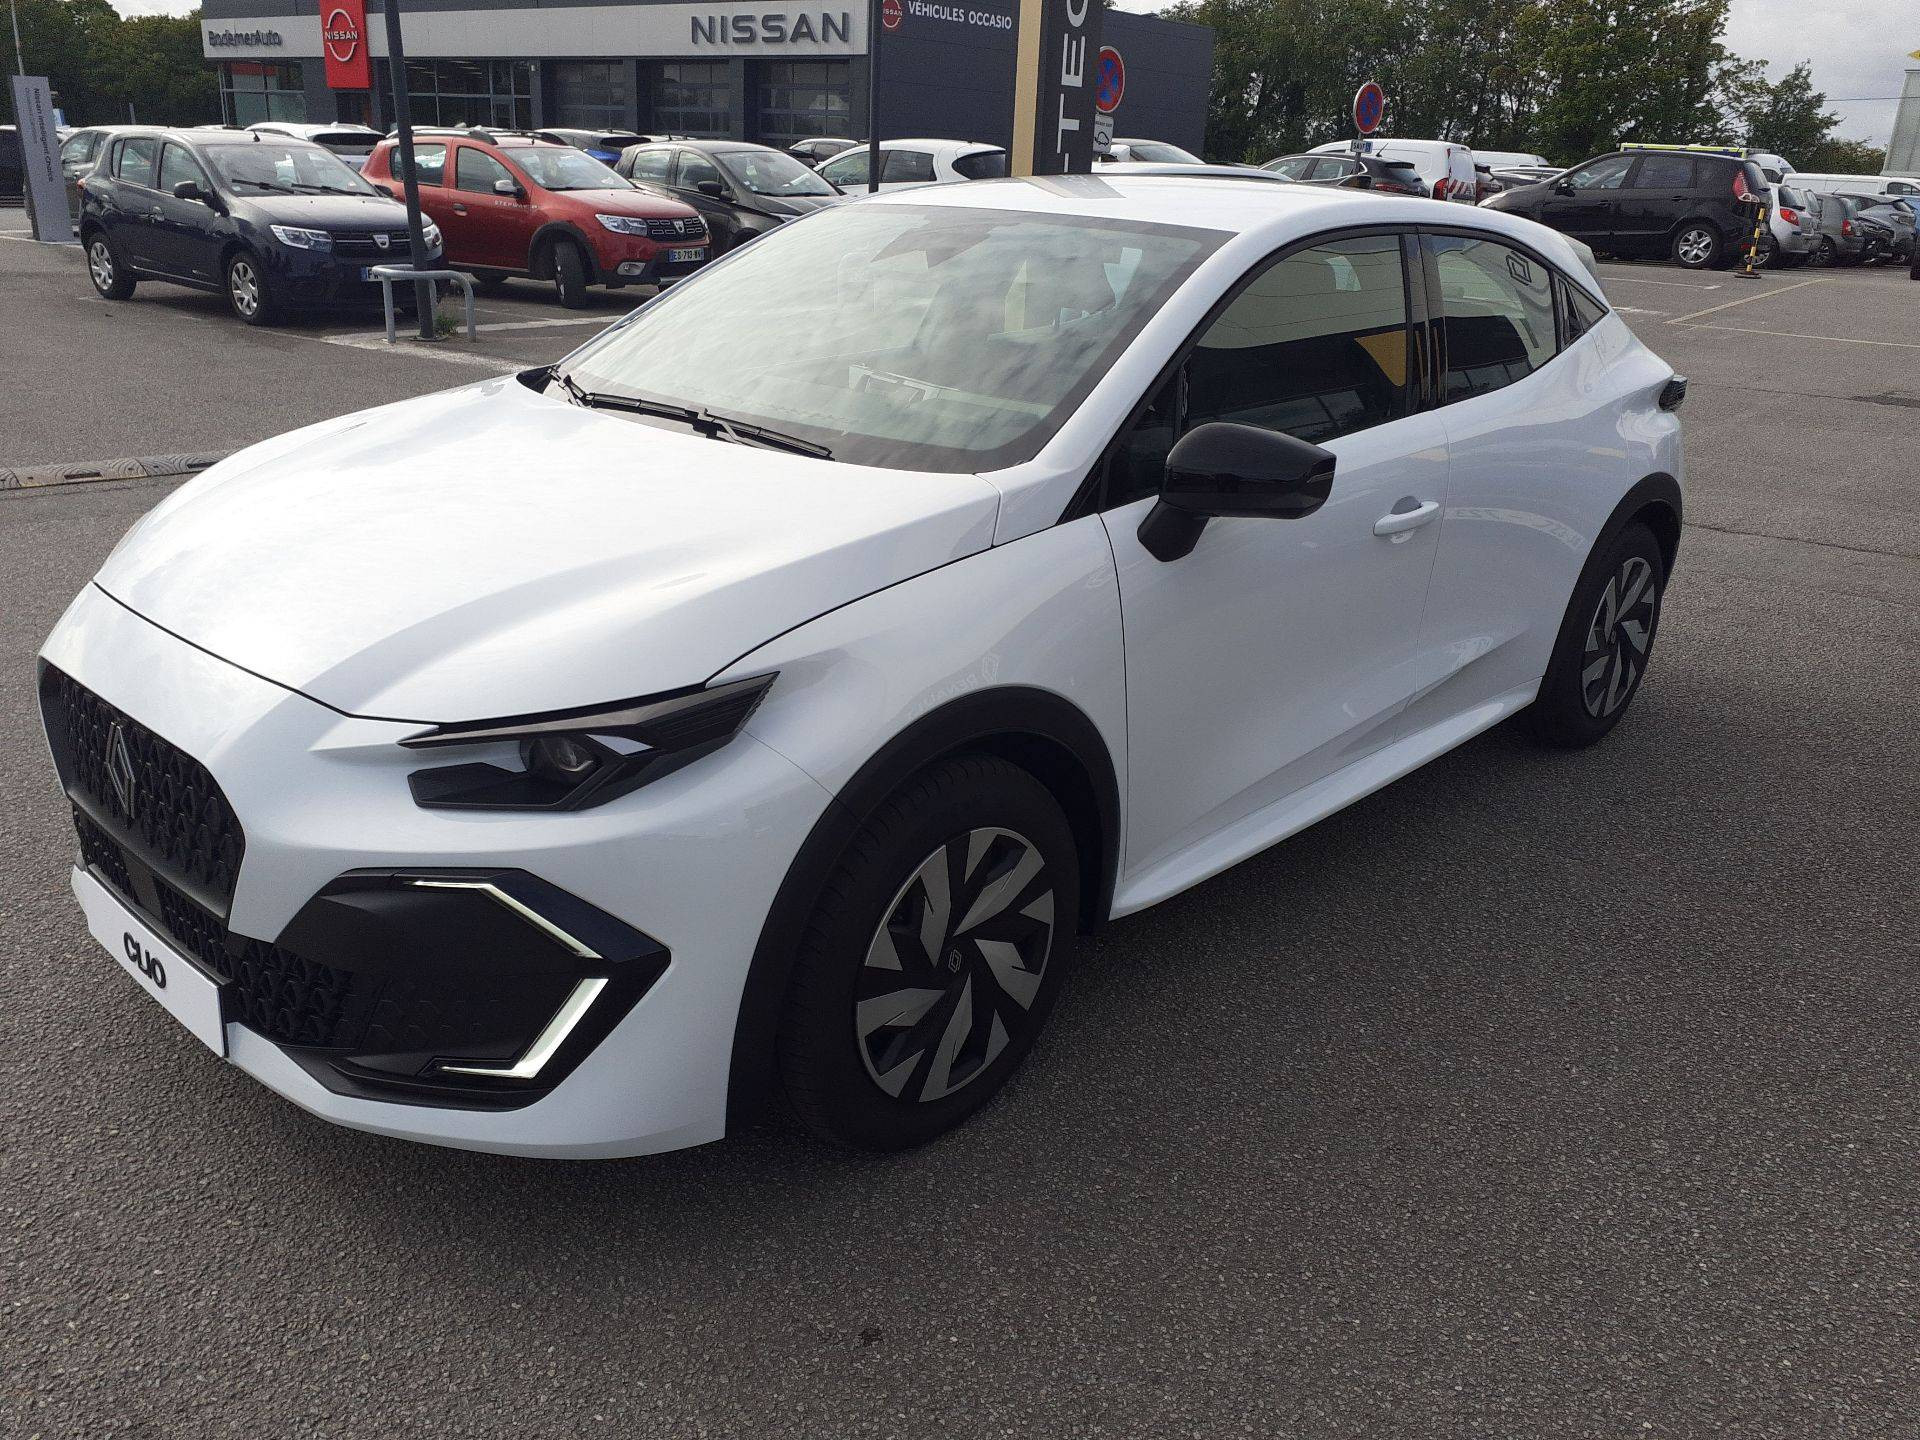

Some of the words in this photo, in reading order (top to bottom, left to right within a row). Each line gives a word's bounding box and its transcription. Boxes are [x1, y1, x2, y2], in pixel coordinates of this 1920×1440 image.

[908, 0, 965, 22] VÉHICULES
[325, 31, 358, 40] NISSAN
[691, 12, 849, 44] NISSAN
[123, 932, 167, 989] CLIO
